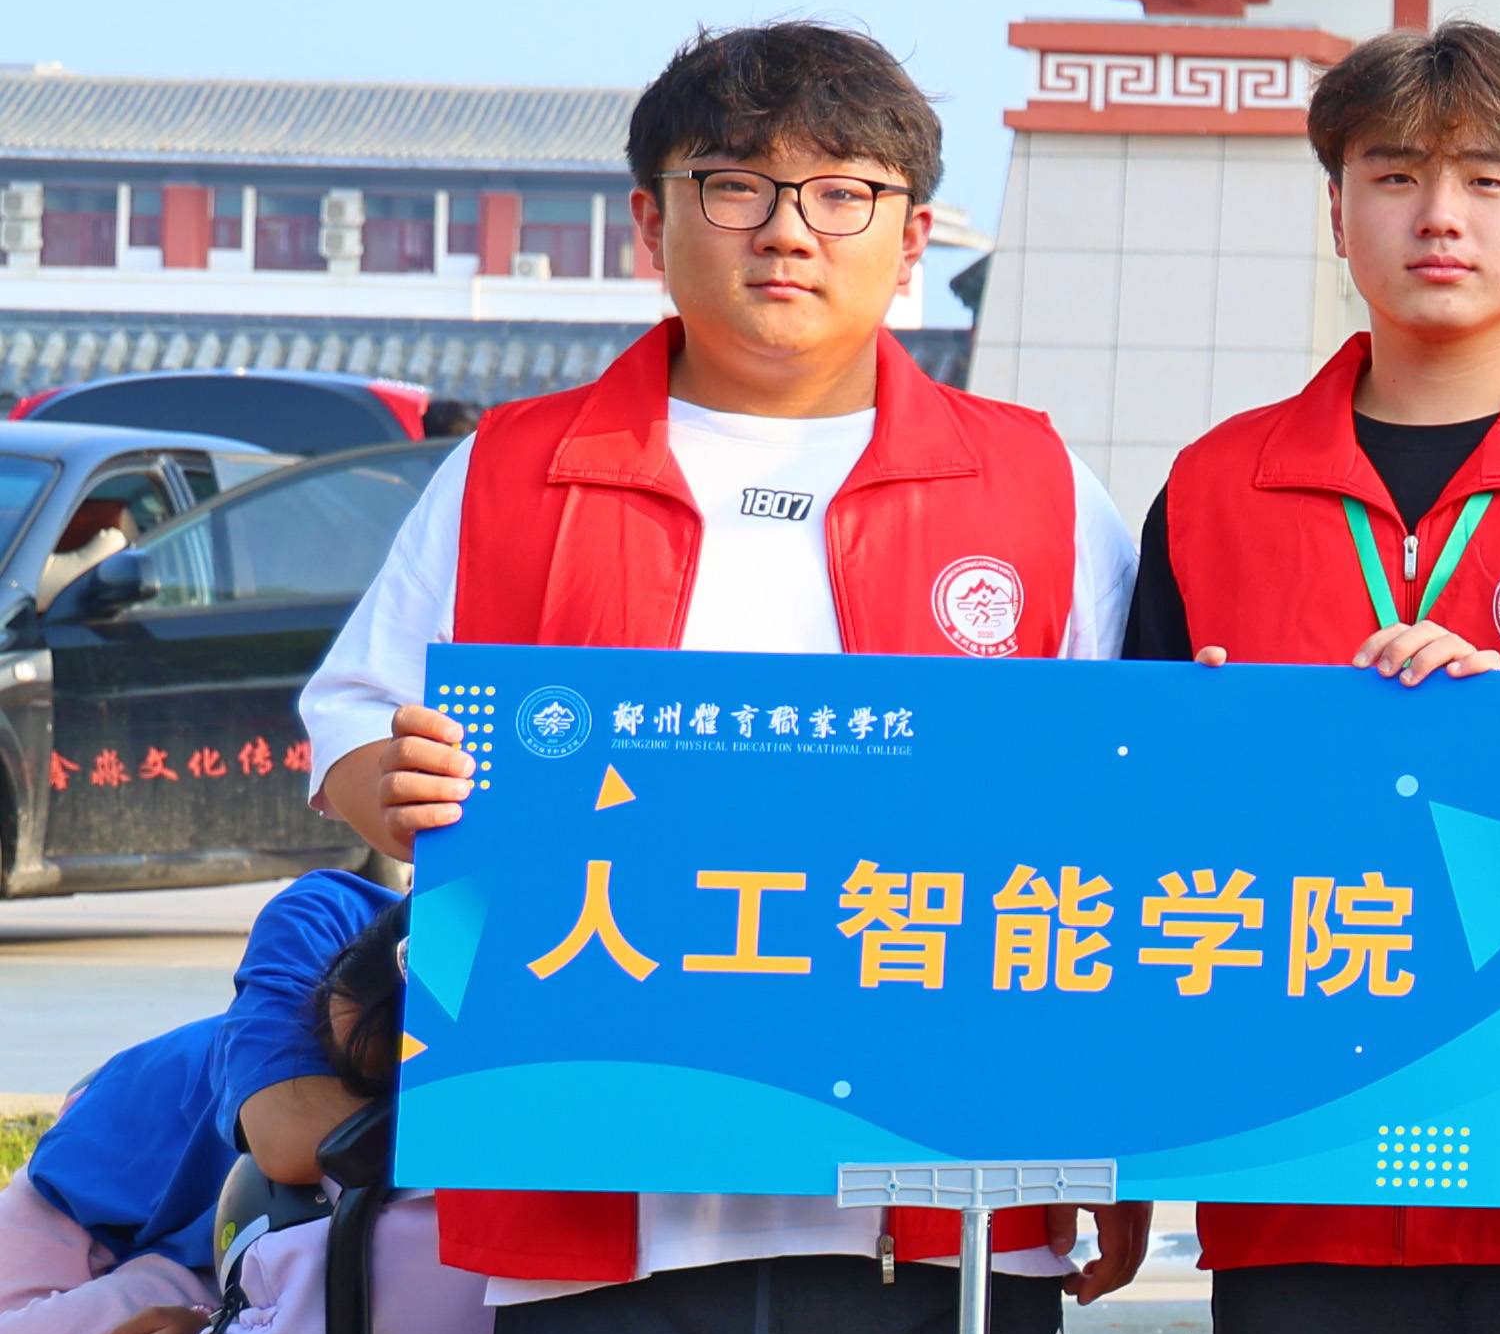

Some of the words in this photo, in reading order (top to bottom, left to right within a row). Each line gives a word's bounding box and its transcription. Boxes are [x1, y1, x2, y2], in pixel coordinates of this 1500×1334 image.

[741, 488, 813, 521] 1807
[613, 700, 915, 740] 鄭州體育職業學院
[610, 738, 670, 750] ZHENGZHOU
[675, 739, 728, 752] PHYSICAL
[732, 741, 792, 753] EDUCATION
[797, 742, 862, 754] VOCATIONAL
[866, 744, 913, 756] COLLEGE
[528, 859, 1415, 997] 人工智能学院
